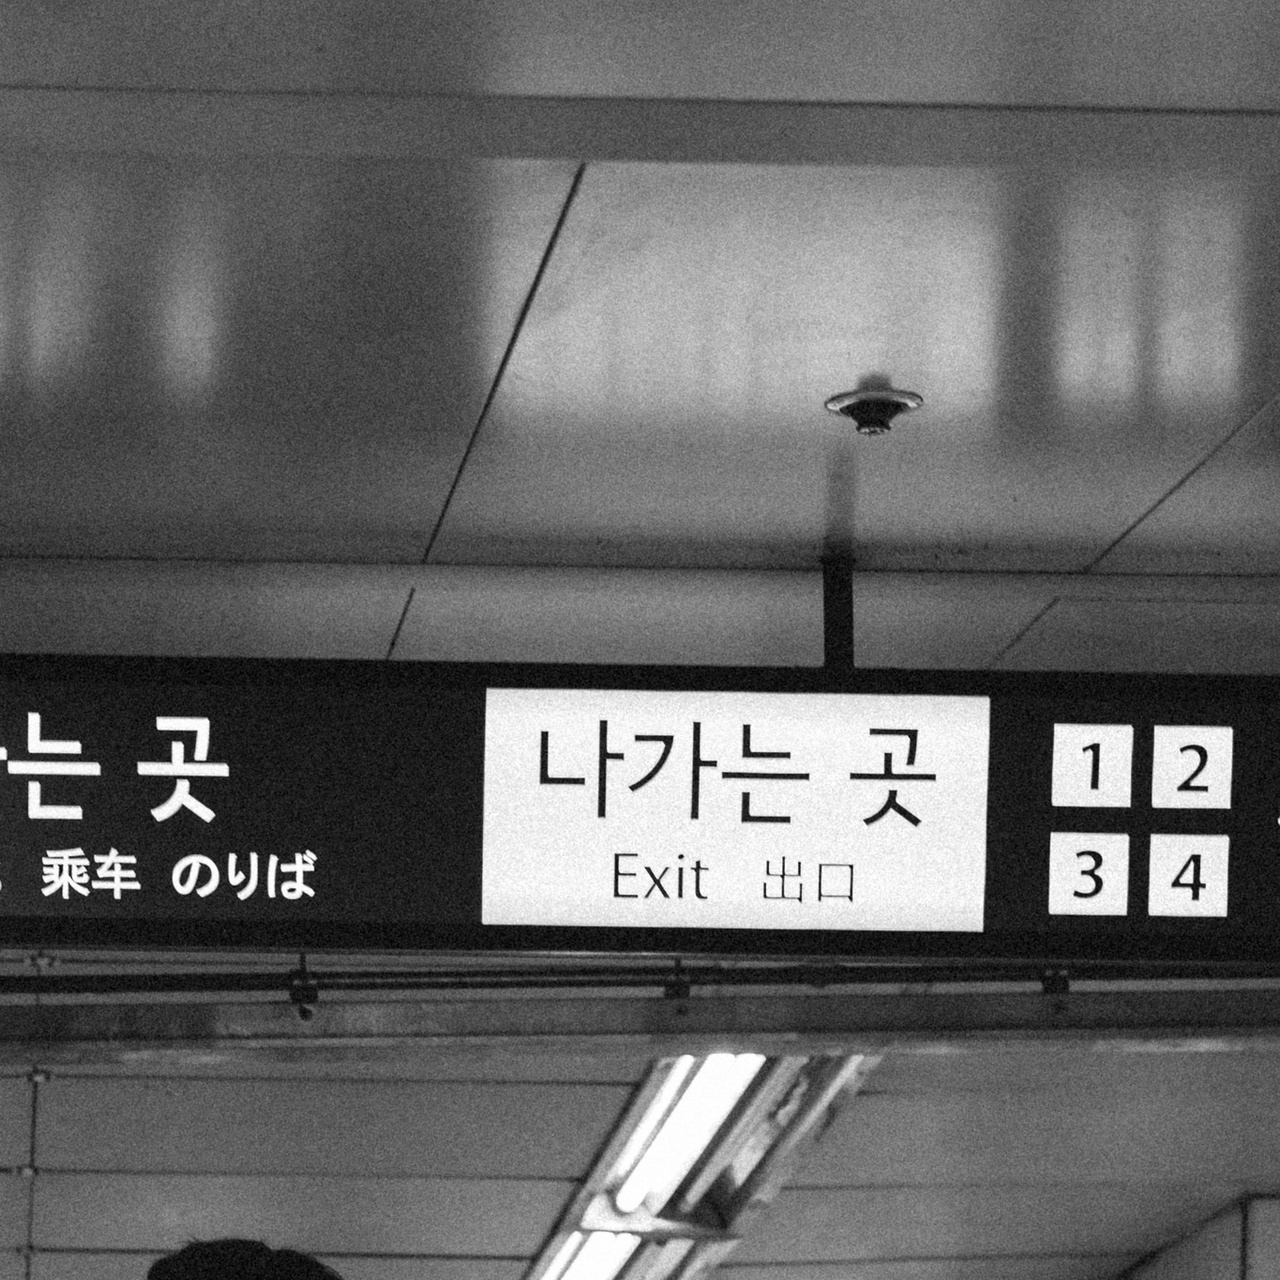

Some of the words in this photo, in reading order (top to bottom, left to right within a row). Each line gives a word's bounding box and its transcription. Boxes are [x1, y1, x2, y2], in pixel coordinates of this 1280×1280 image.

[137, 716, 230, 823] 곳
[539, 719, 810, 824] 나가는
[849, 727, 937, 827] 곳
[1081, 742, 1102, 791] 1
[1176, 743, 1209, 793] 2
[171, 849, 318, 901] のりば
[613, 852, 709, 901] Exit
[762, 855, 855, 904] 出口
[1073, 849, 1104, 899] 3
[1170, 853, 1207, 901] 4
